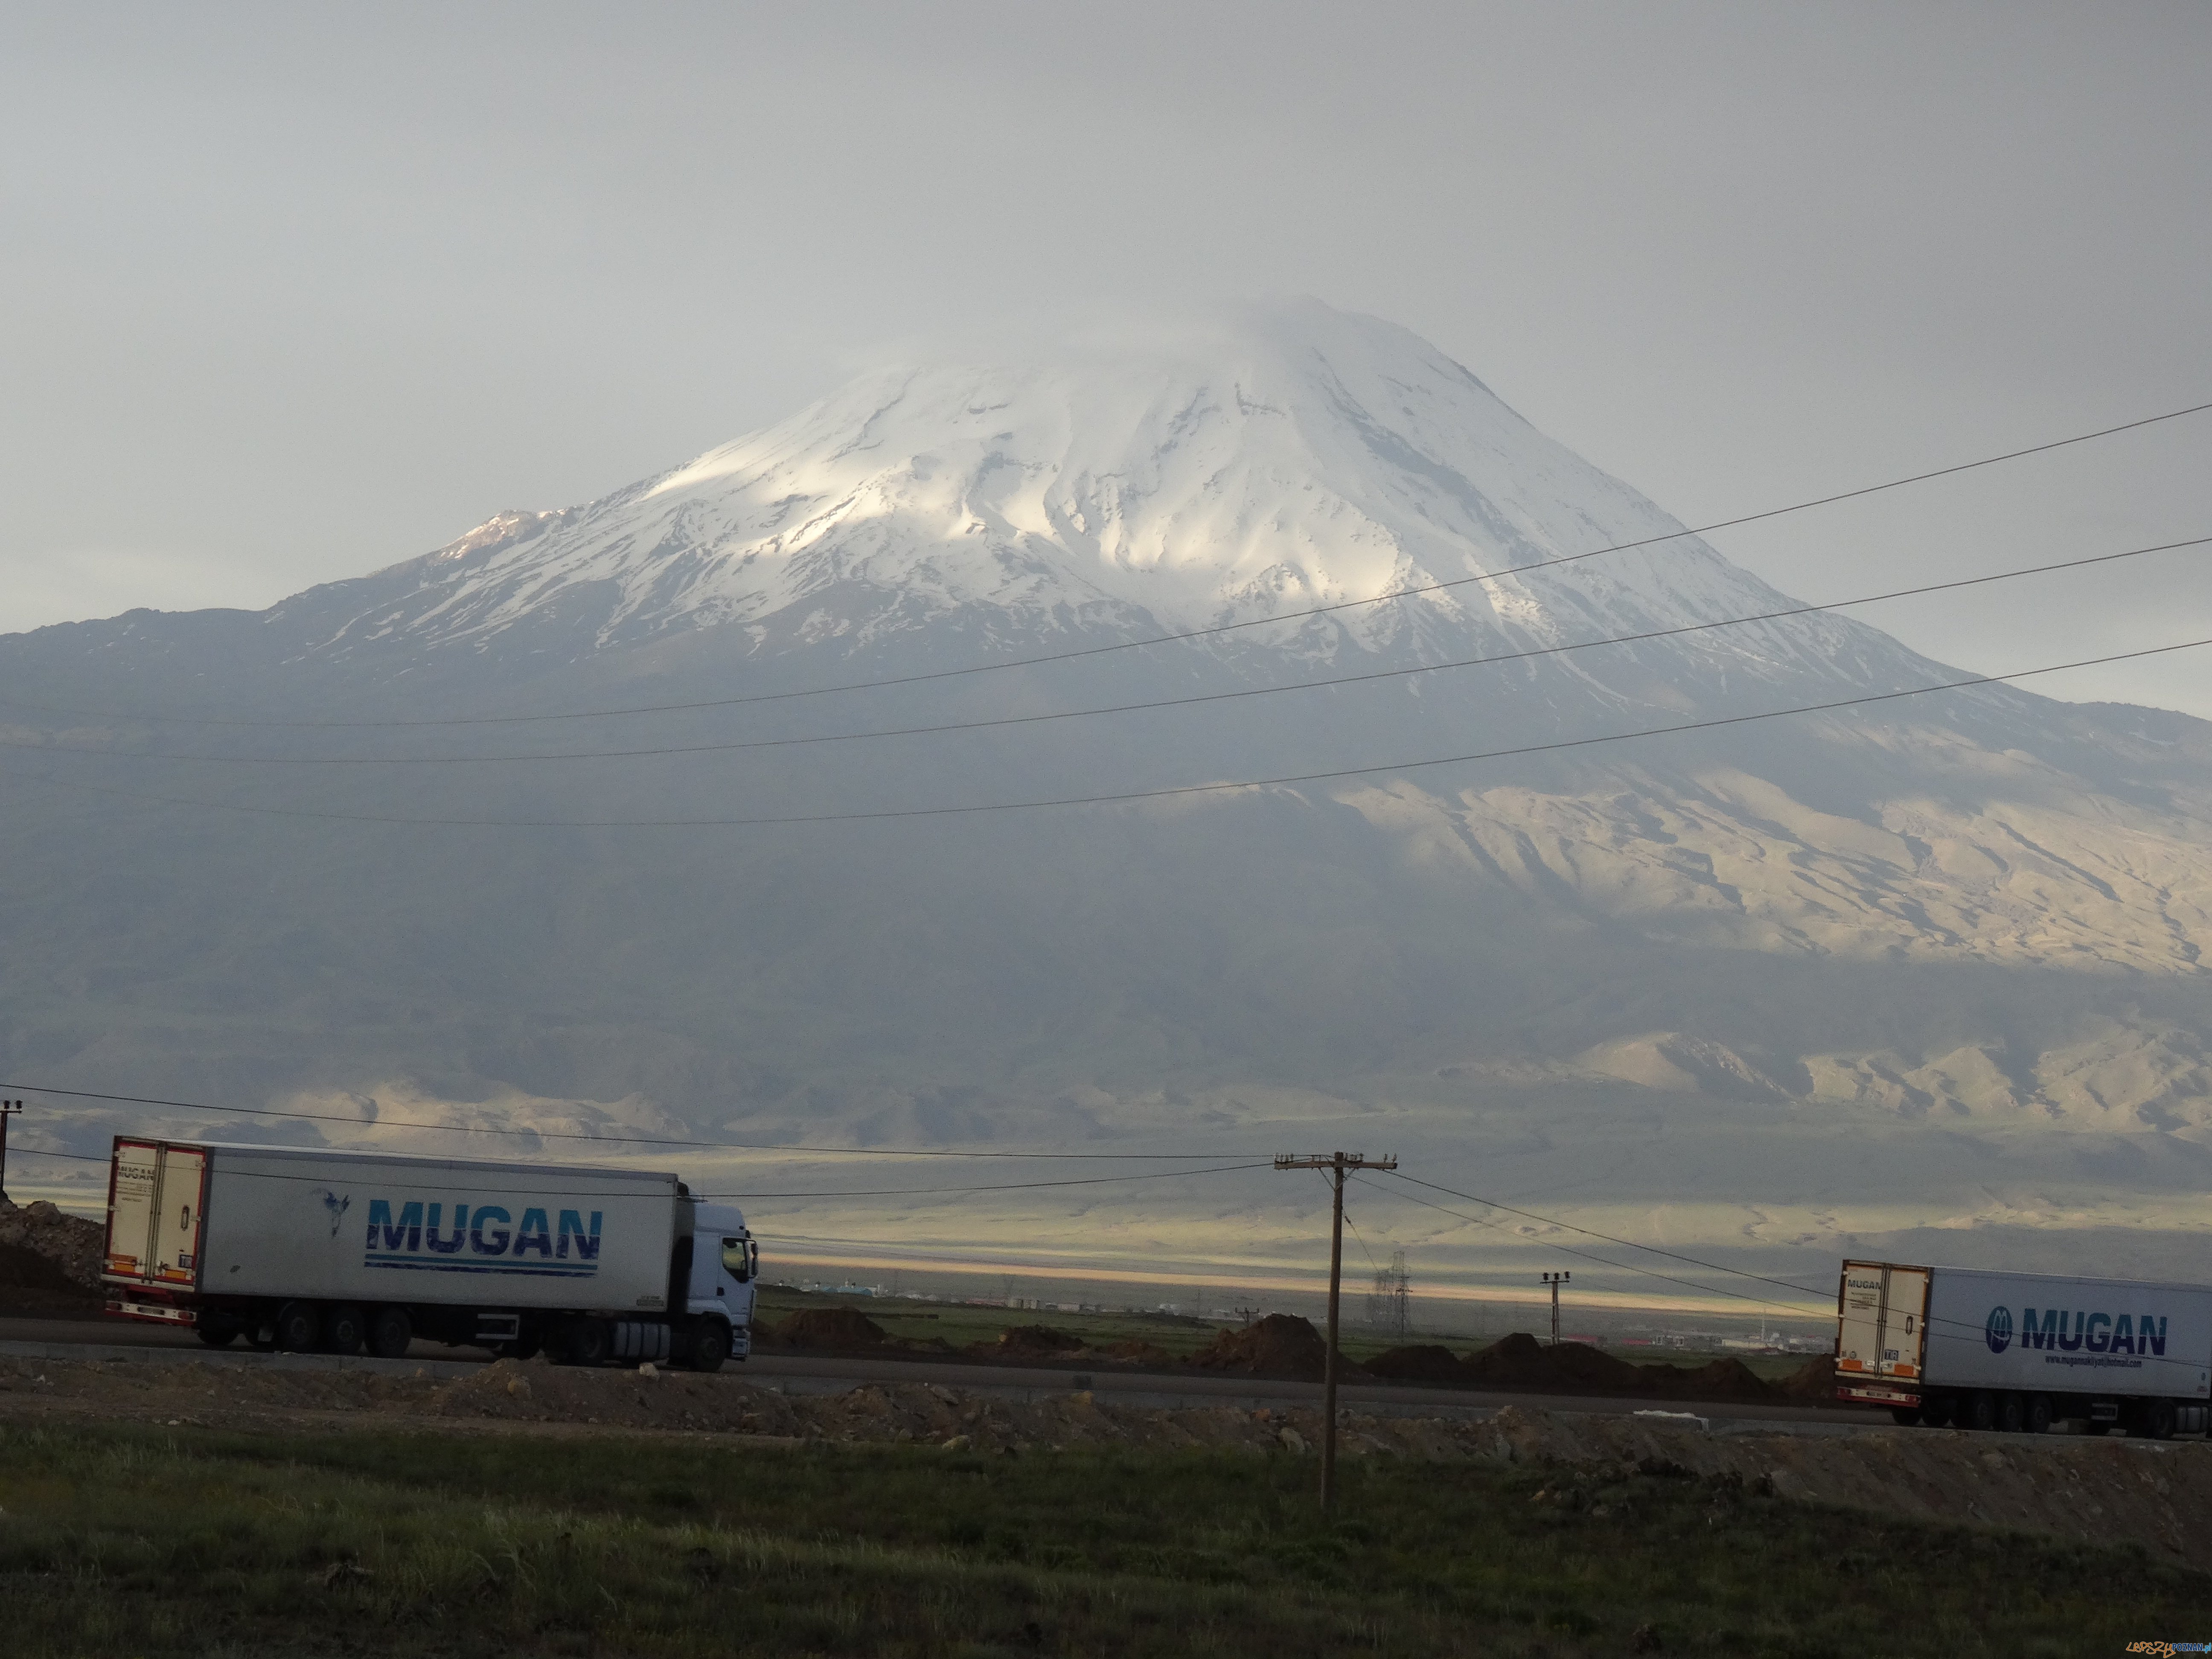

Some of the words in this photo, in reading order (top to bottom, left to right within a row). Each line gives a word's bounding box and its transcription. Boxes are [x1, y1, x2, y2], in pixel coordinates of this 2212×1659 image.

[117, 1166, 154, 1181] MUGAN
[366, 1199, 603, 1260] MUGAN
[1848, 1279, 1881, 1289] MUGAN
[2021, 1308, 2168, 1356] MUGAN
[1886, 1350, 1898, 1360] TIR
